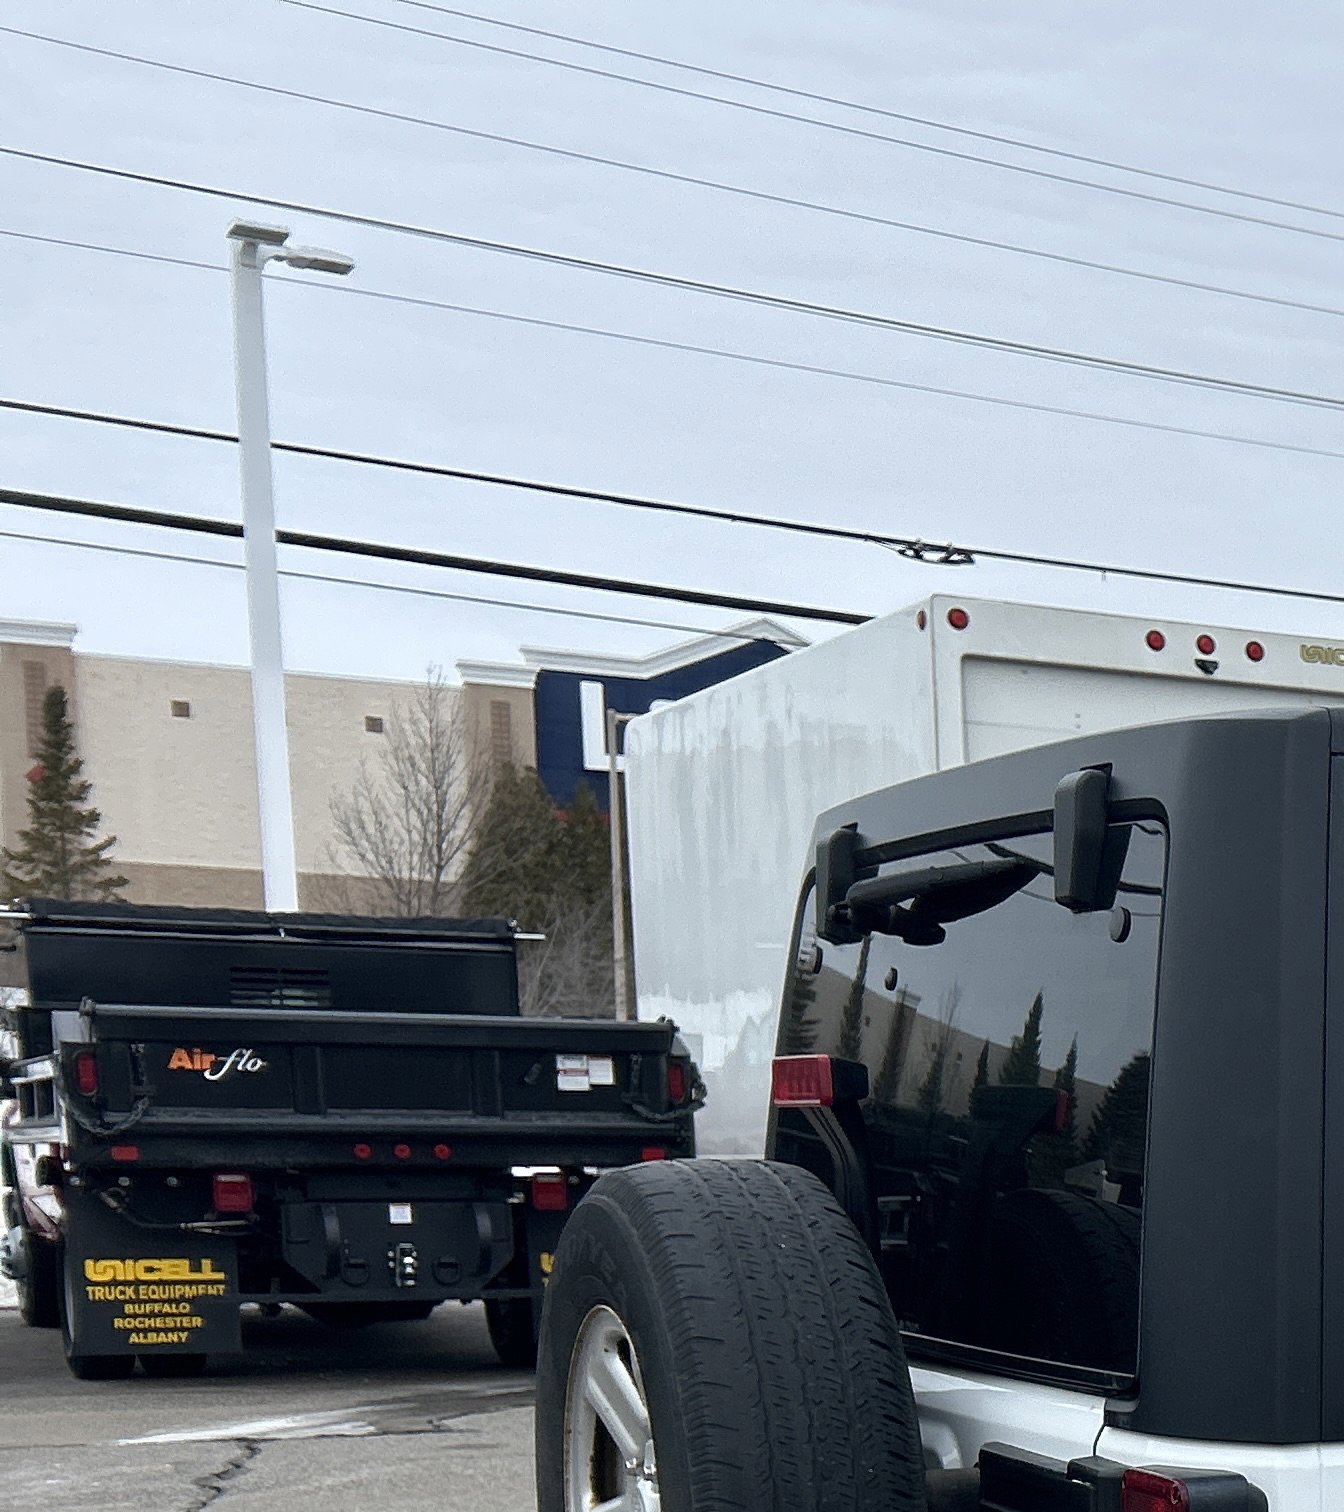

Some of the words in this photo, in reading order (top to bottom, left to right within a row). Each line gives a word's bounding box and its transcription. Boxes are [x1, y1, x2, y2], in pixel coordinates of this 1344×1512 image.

[84, 1258, 225, 1282] UNICELL
[86, 1285, 136, 1301] TRUCK
[139, 1284, 225, 1301] EQUIPMENT
[123, 1302, 190, 1315] BUFFALO
[113, 1316, 203, 1329] ROCHESTER
[128, 1331, 189, 1344] ALBANY
